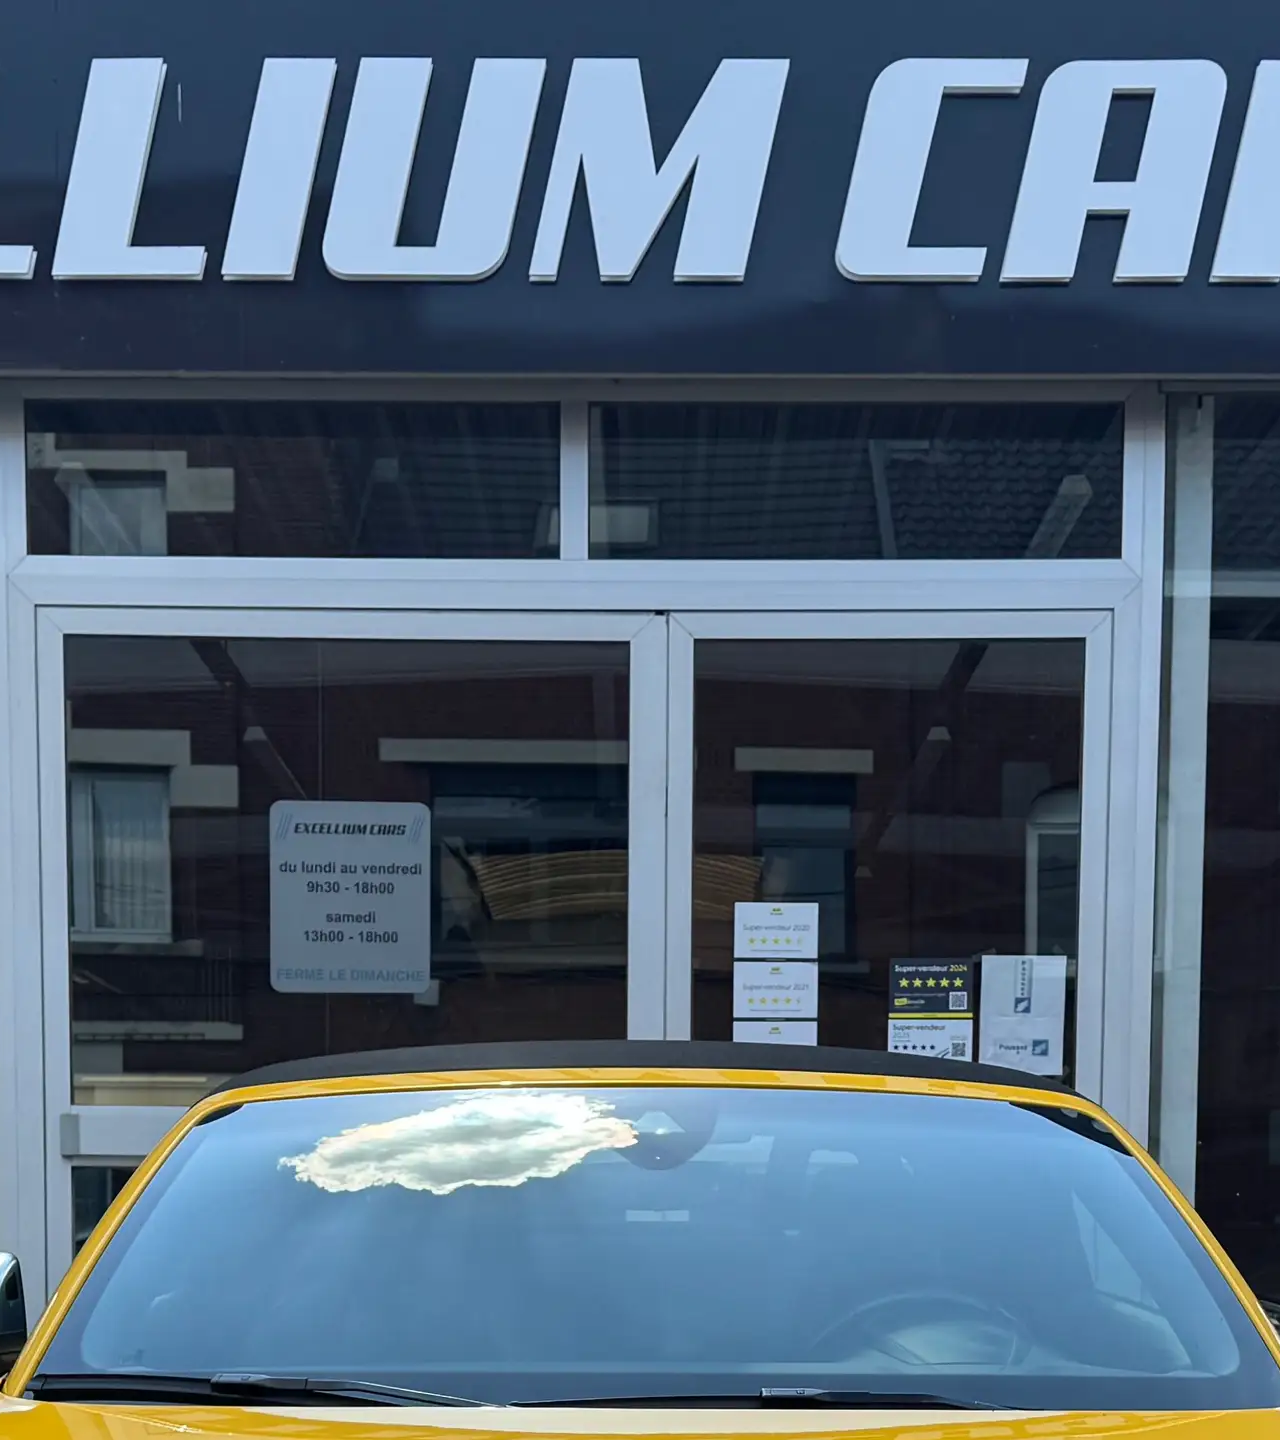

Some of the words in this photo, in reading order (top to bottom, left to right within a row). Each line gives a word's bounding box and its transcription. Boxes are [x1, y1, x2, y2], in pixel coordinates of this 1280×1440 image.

[294, 822, 368, 836] EXCELLIUM
[369, 823, 407, 837] CARS
[279, 861, 297, 874] du
[301, 860, 336, 875] lundi
[340, 863, 358, 875] au
[361, 862, 422, 876] vendredi
[306, 881, 340, 894] 9h30
[354, 882, 395, 895] 18h00
[325, 911, 376, 924] samedi
[304, 930, 344, 943] 13h00
[358, 931, 399, 944] 18h00
[276, 968, 324, 981] FERME
[328, 968, 347, 981] LE
[350, 969, 426, 983] DIMANCHE
